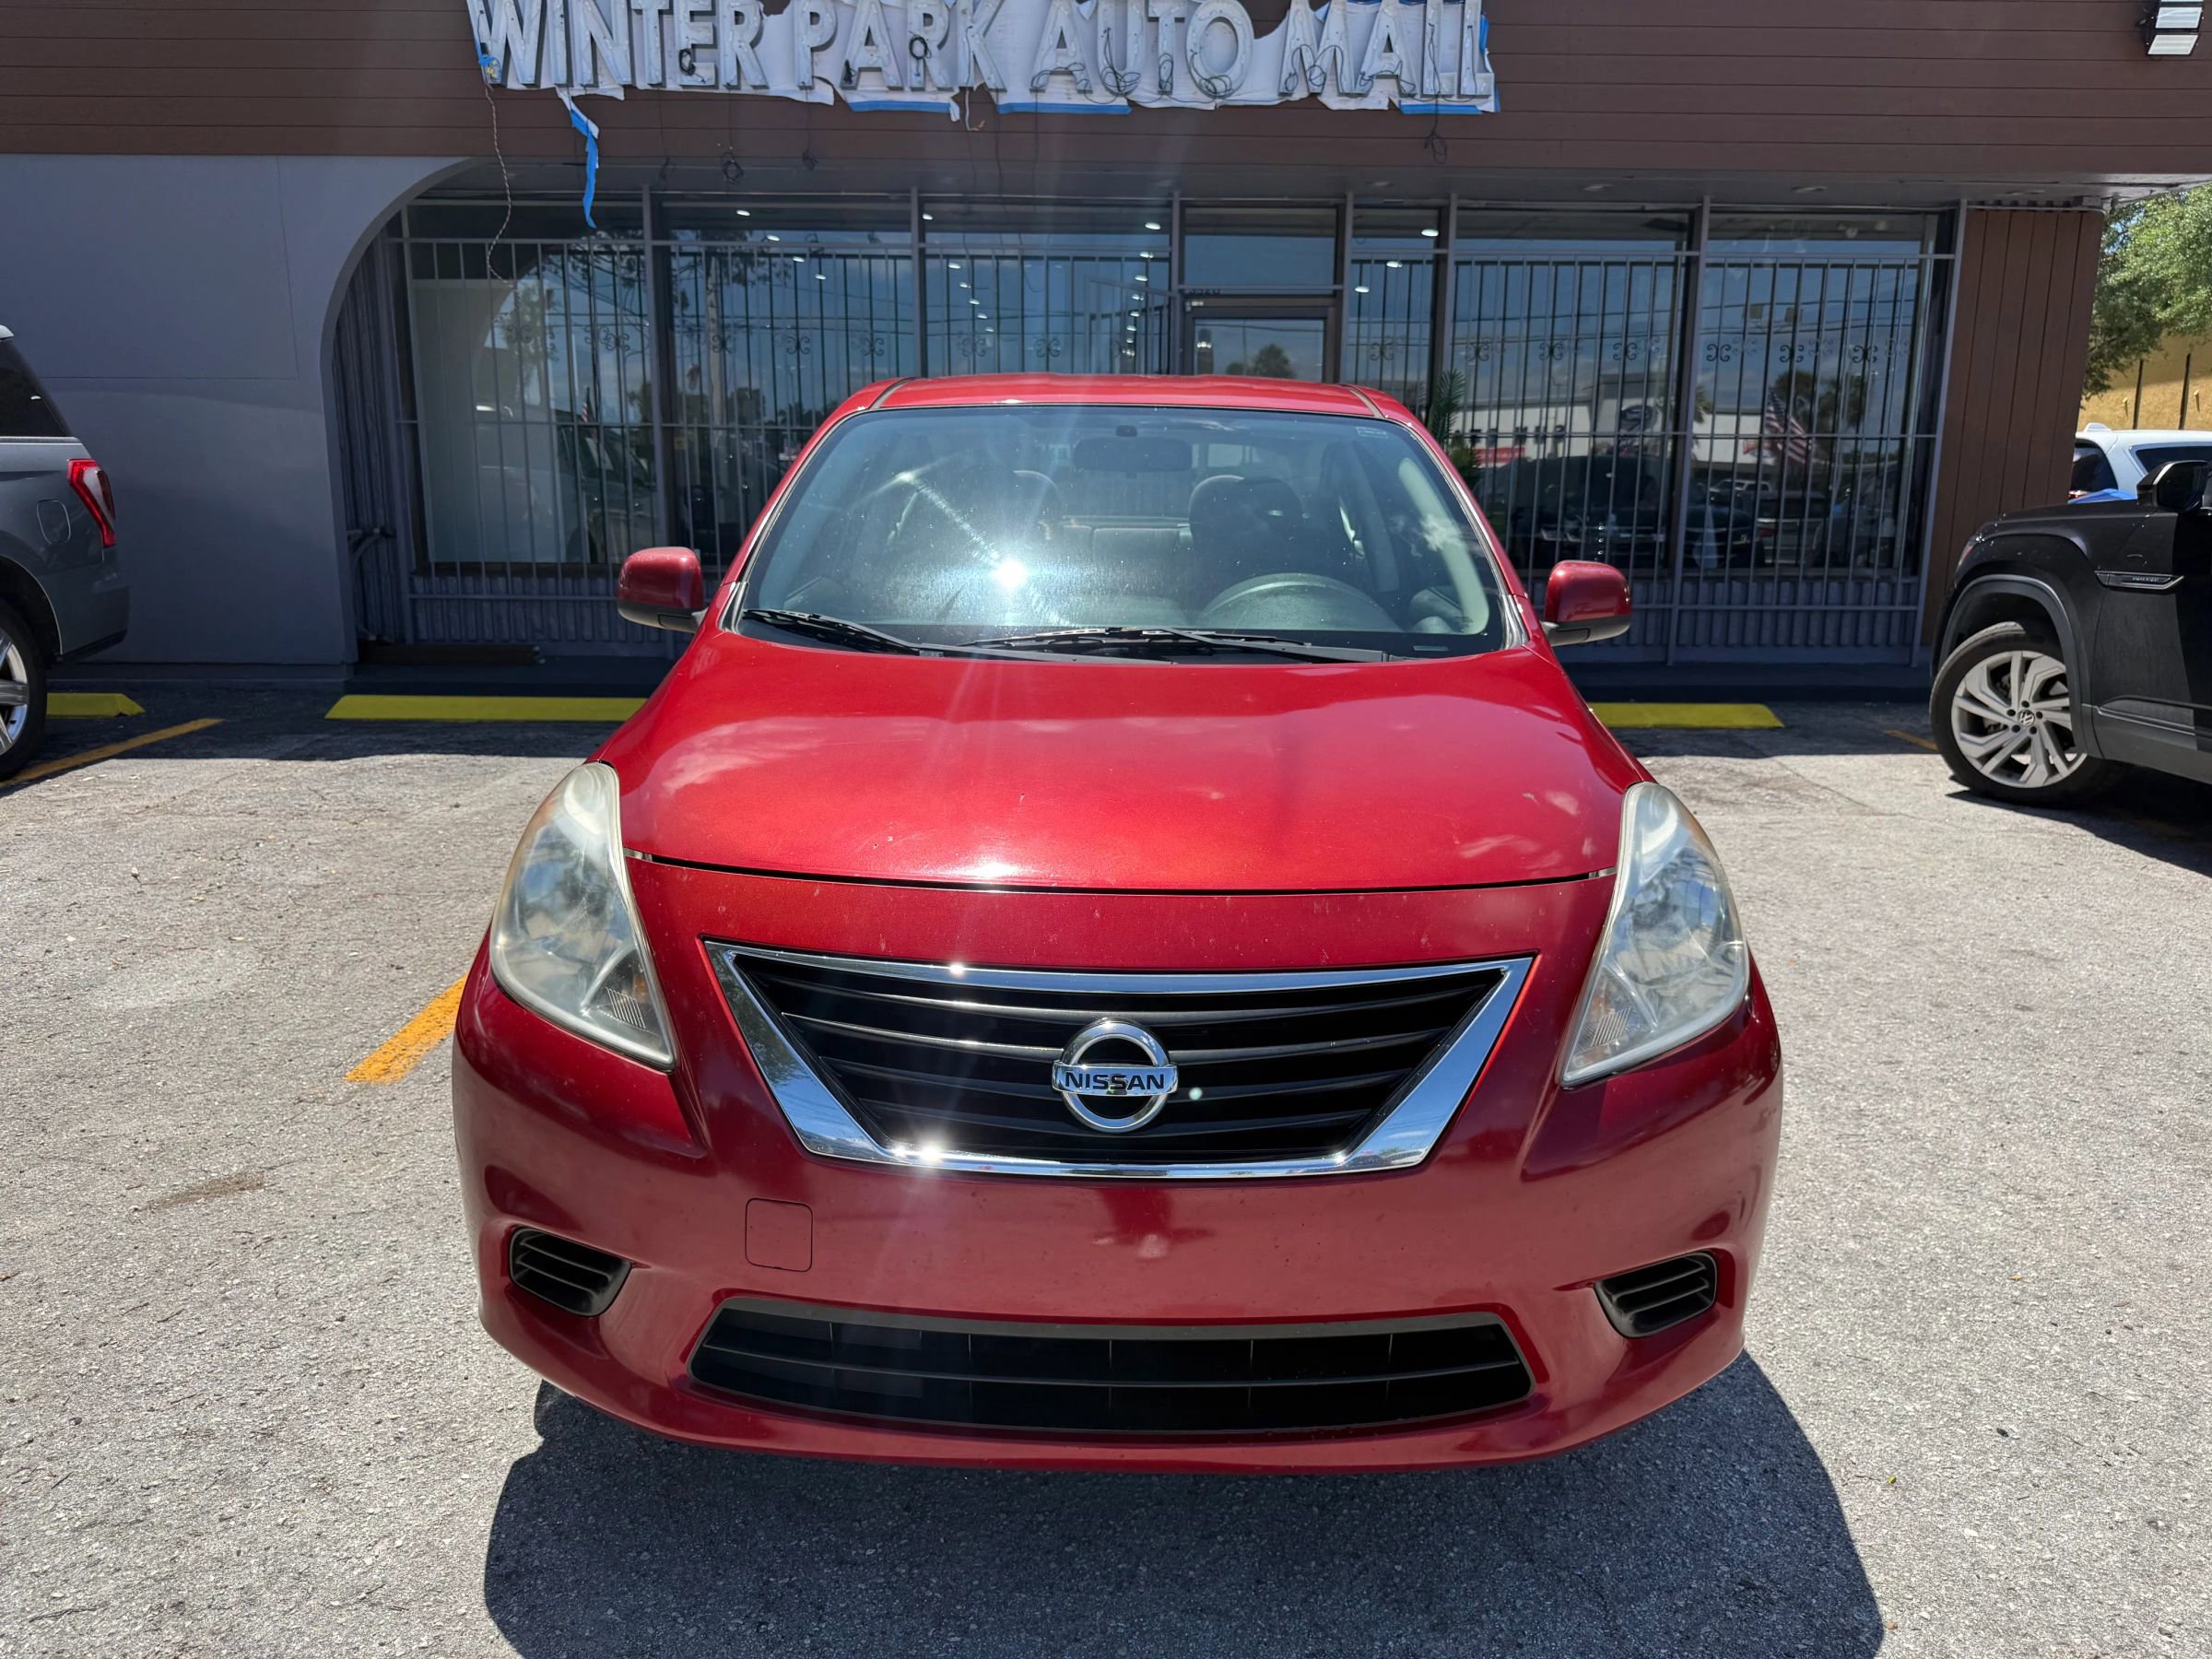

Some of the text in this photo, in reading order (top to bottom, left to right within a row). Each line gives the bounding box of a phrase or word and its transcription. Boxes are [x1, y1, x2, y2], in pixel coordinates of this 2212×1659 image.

[467, 0, 1495, 99] WINTER PARK AUTO MALL
[1065, 1071, 1164, 1090] NISSAN
